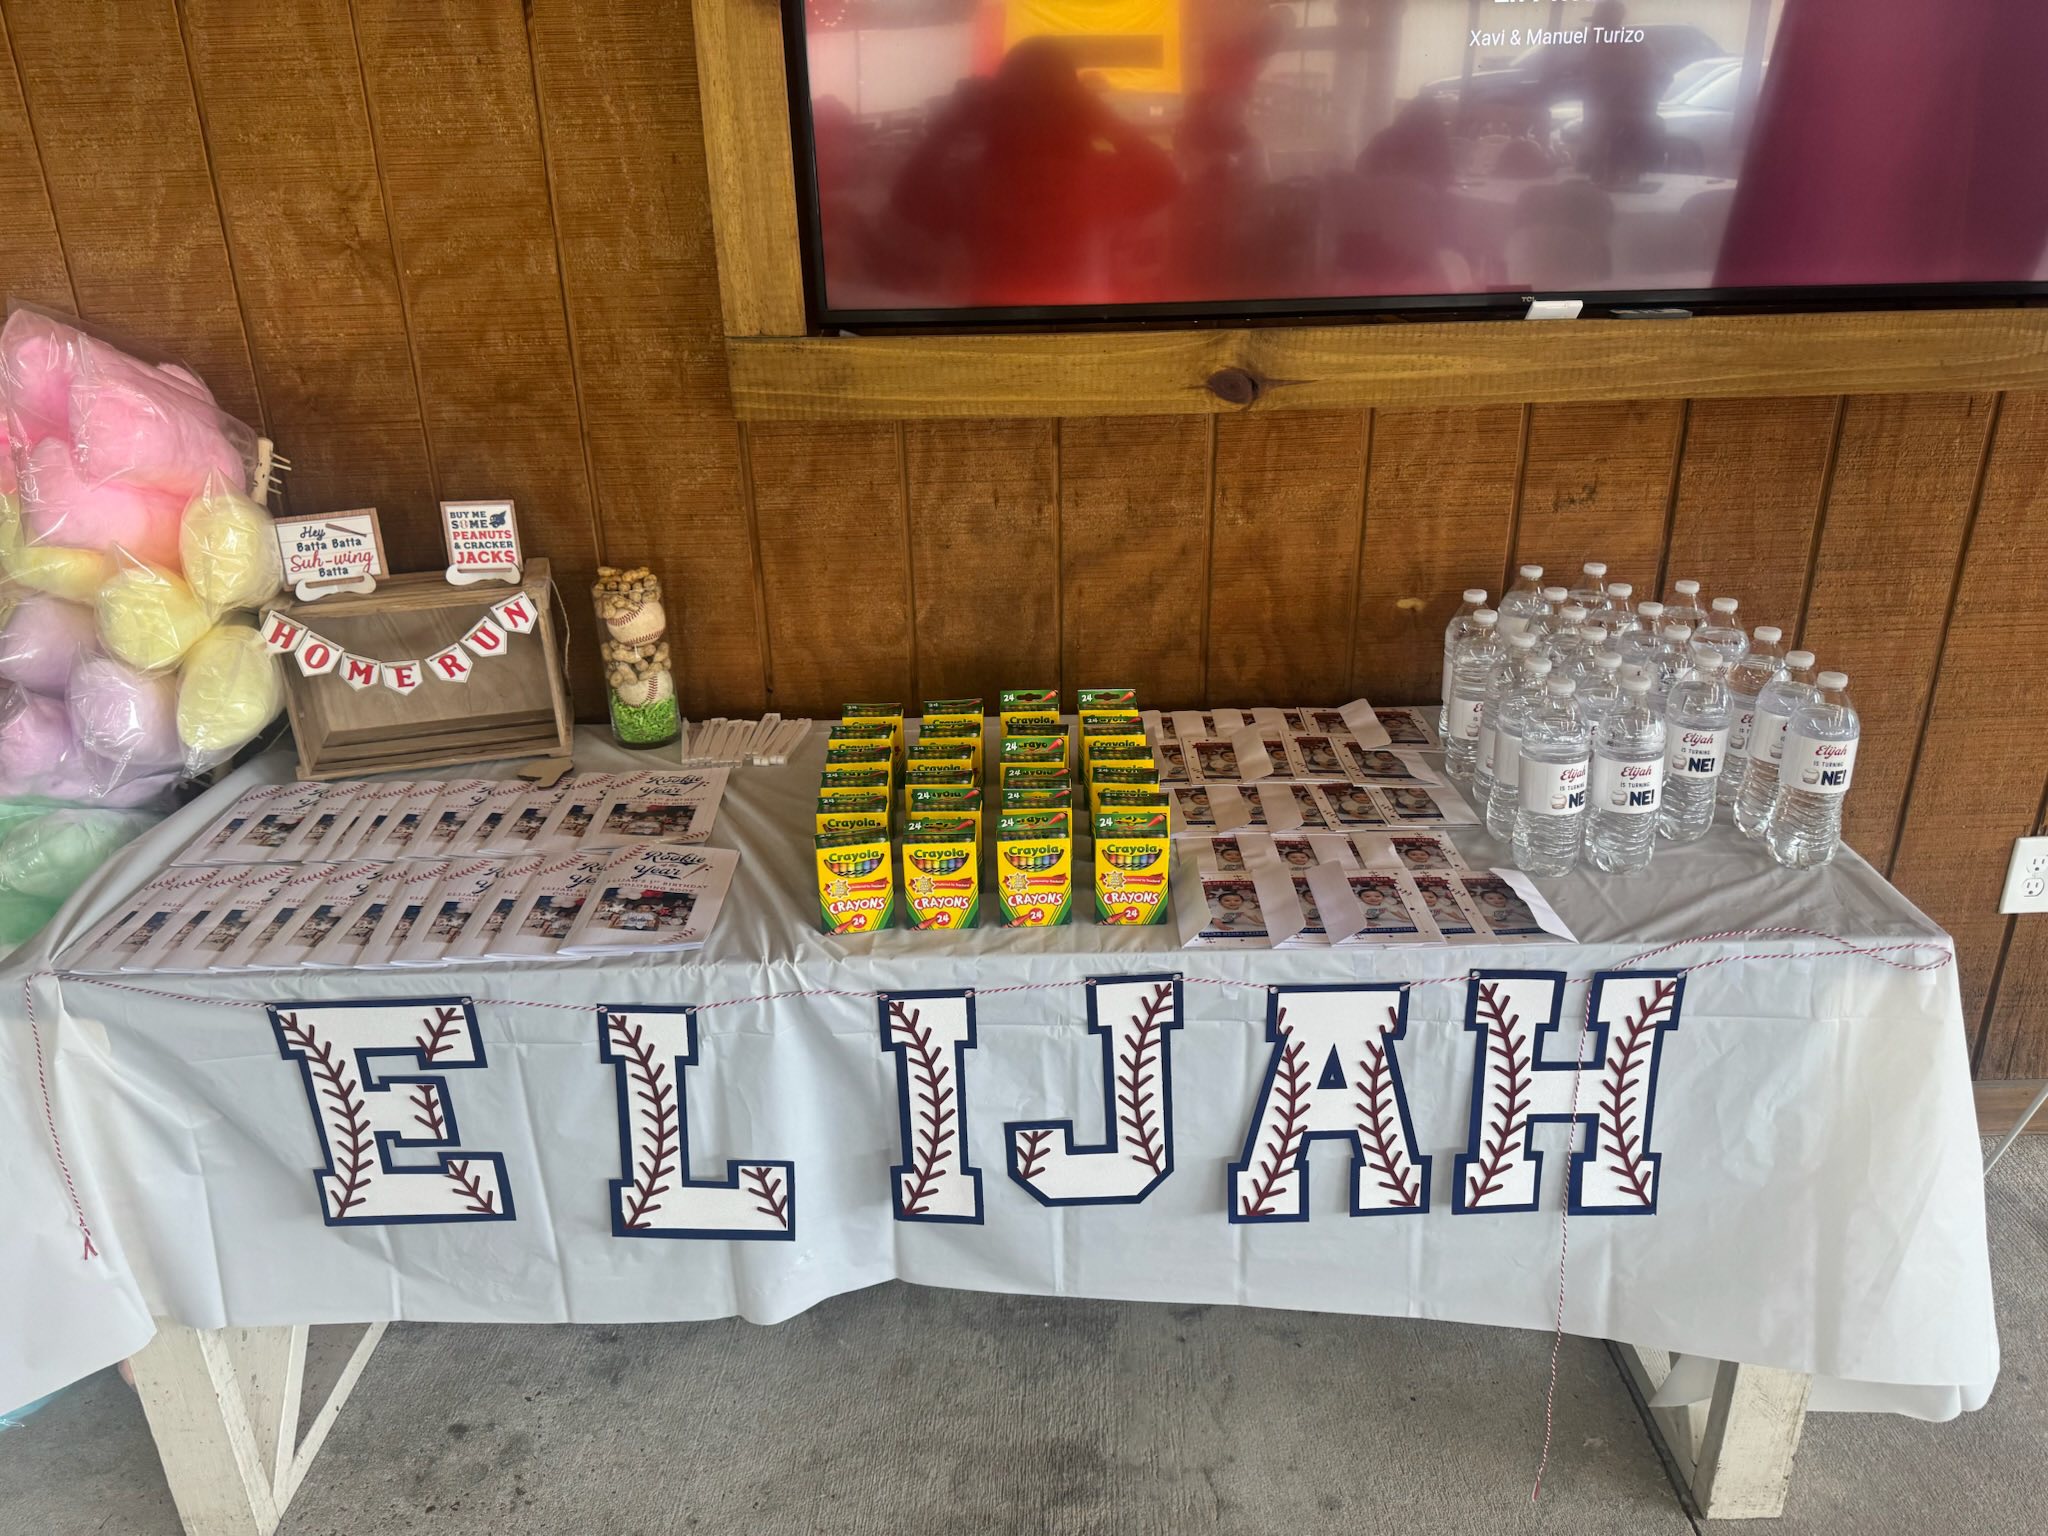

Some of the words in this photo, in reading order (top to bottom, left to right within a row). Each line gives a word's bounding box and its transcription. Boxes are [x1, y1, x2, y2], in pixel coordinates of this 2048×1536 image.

[1470, 29, 1505, 46] Xavi
[1510, 29, 1521, 46] &
[1526, 27, 1588, 45] Manuel
[1593, 27, 1644, 44] Turizo
[450, 511, 471, 519] BUY
[472, 510, 487, 519] ME
[299, 525, 326, 540] Hey
[453, 530, 512, 540] PEANUTS
[296, 538, 328, 552] Batta
[332, 536, 362, 549] Batta
[463, 541, 514, 550] CRACKER
[290, 549, 373, 574] Suh-wing
[456, 550, 516, 564] JACKS
[318, 565, 349, 577] Batta
[268, 620, 415, 689] HOME
[437, 600, 530, 679] RUN
[1003, 694, 1015, 702] 24
[1081, 694, 1093, 702] 24
[1009, 716, 1050, 725] Crayola
[1682, 732, 1714, 747] Elijah
[1005, 742, 1018, 751] 24
[1815, 744, 1847, 759] Elijah
[1620, 765, 1652, 780] Elijah
[645, 775, 704, 785] Rookie
[637, 786, 682, 798] Year
[917, 791, 930, 800] 24
[827, 818, 876, 829] Crayola
[909, 822, 922, 831] 24
[1001, 818, 1014, 827] 24
[1099, 817, 1113, 827] 24
[829, 848, 880, 863] Crayola
[914, 847, 965, 862] Crayola
[1009, 844, 1059, 856] Crayola
[1106, 844, 1158, 855] Crayola
[641, 850, 707, 866] Rookie
[630, 863, 682, 881] Year
[663, 881, 709, 889] BIRTHDAY
[914, 896, 970, 913] CRAYONS
[1008, 893, 1063, 906] CRAYONS
[1103, 892, 1159, 905] CRAYONS
[829, 896, 886, 914] CRAYONS
[936, 914, 949, 923] 24
[1030, 910, 1043, 919] 24
[1126, 909, 1138, 918] 24
[852, 916, 866, 925] 24
[266, 970, 1689, 1241] ELIJAH
